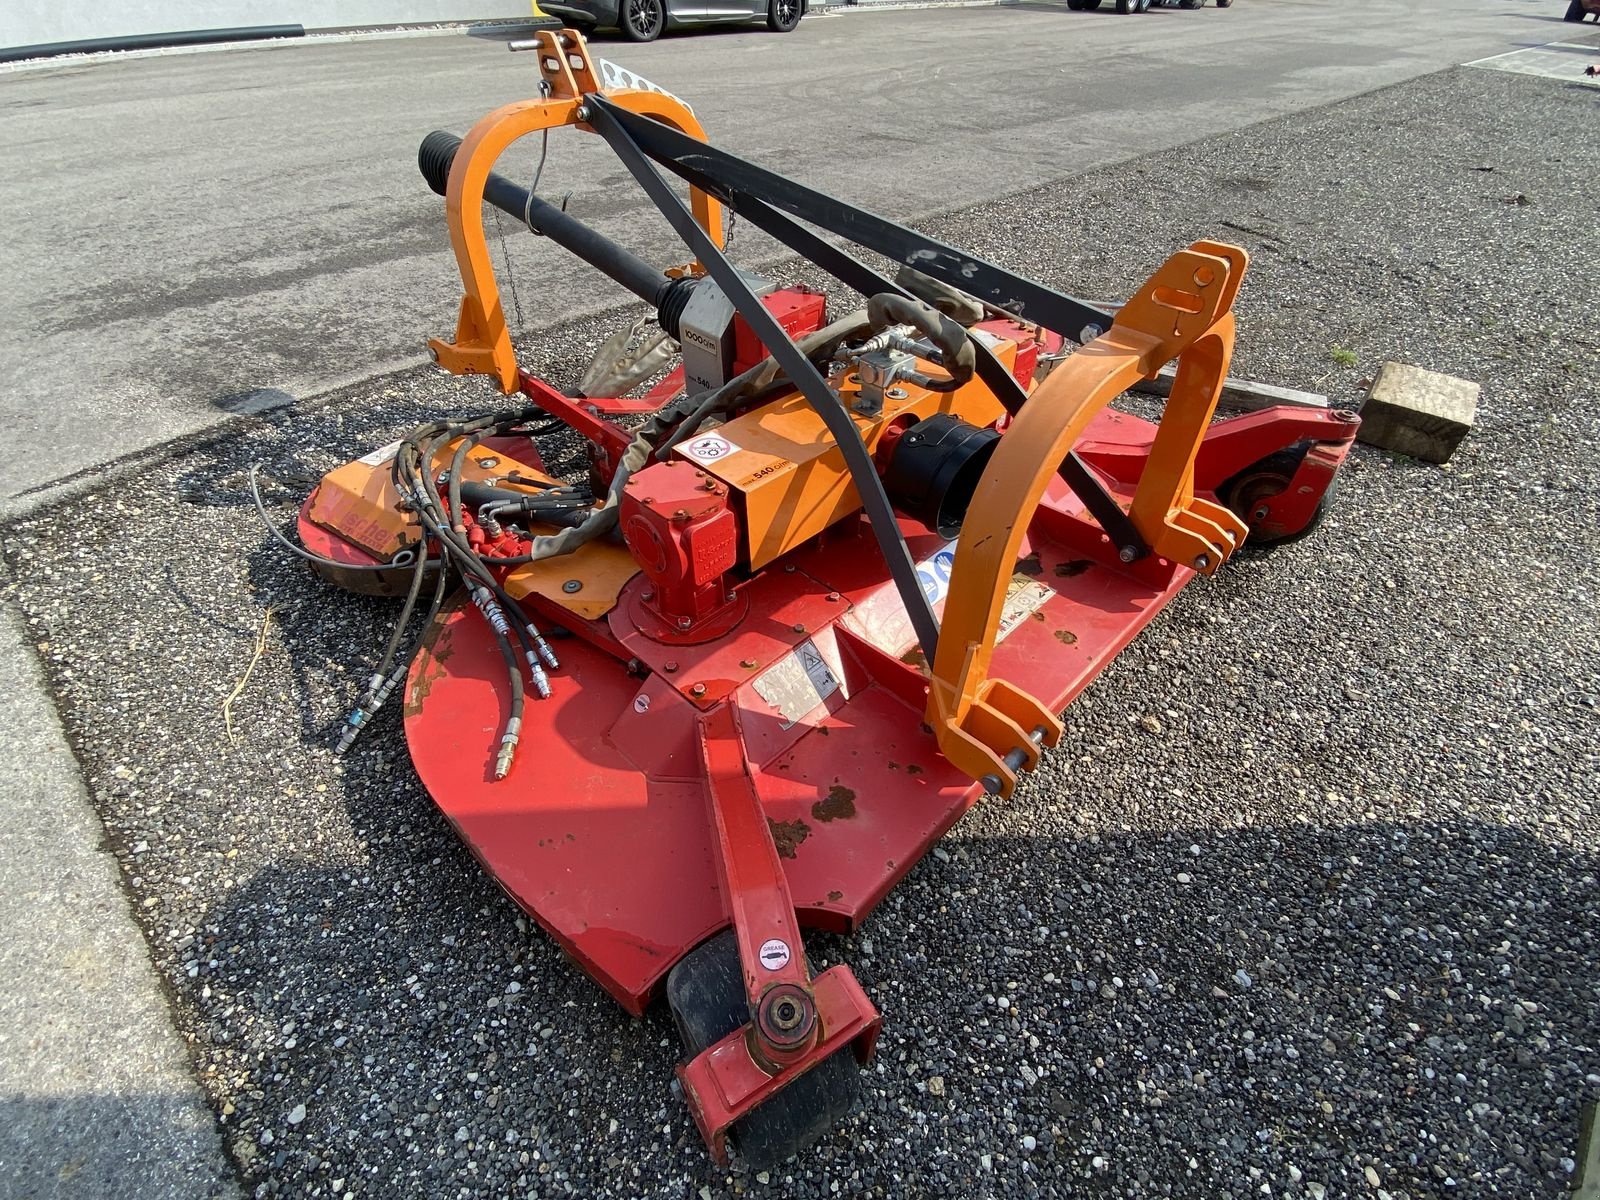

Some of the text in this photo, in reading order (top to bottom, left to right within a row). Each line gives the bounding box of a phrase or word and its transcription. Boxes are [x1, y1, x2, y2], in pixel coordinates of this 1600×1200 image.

[685, 329, 703, 344] 1000
[697, 376, 711, 390] 540
[752, 466, 775, 479] 540
[763, 944, 785, 952] GREASE
